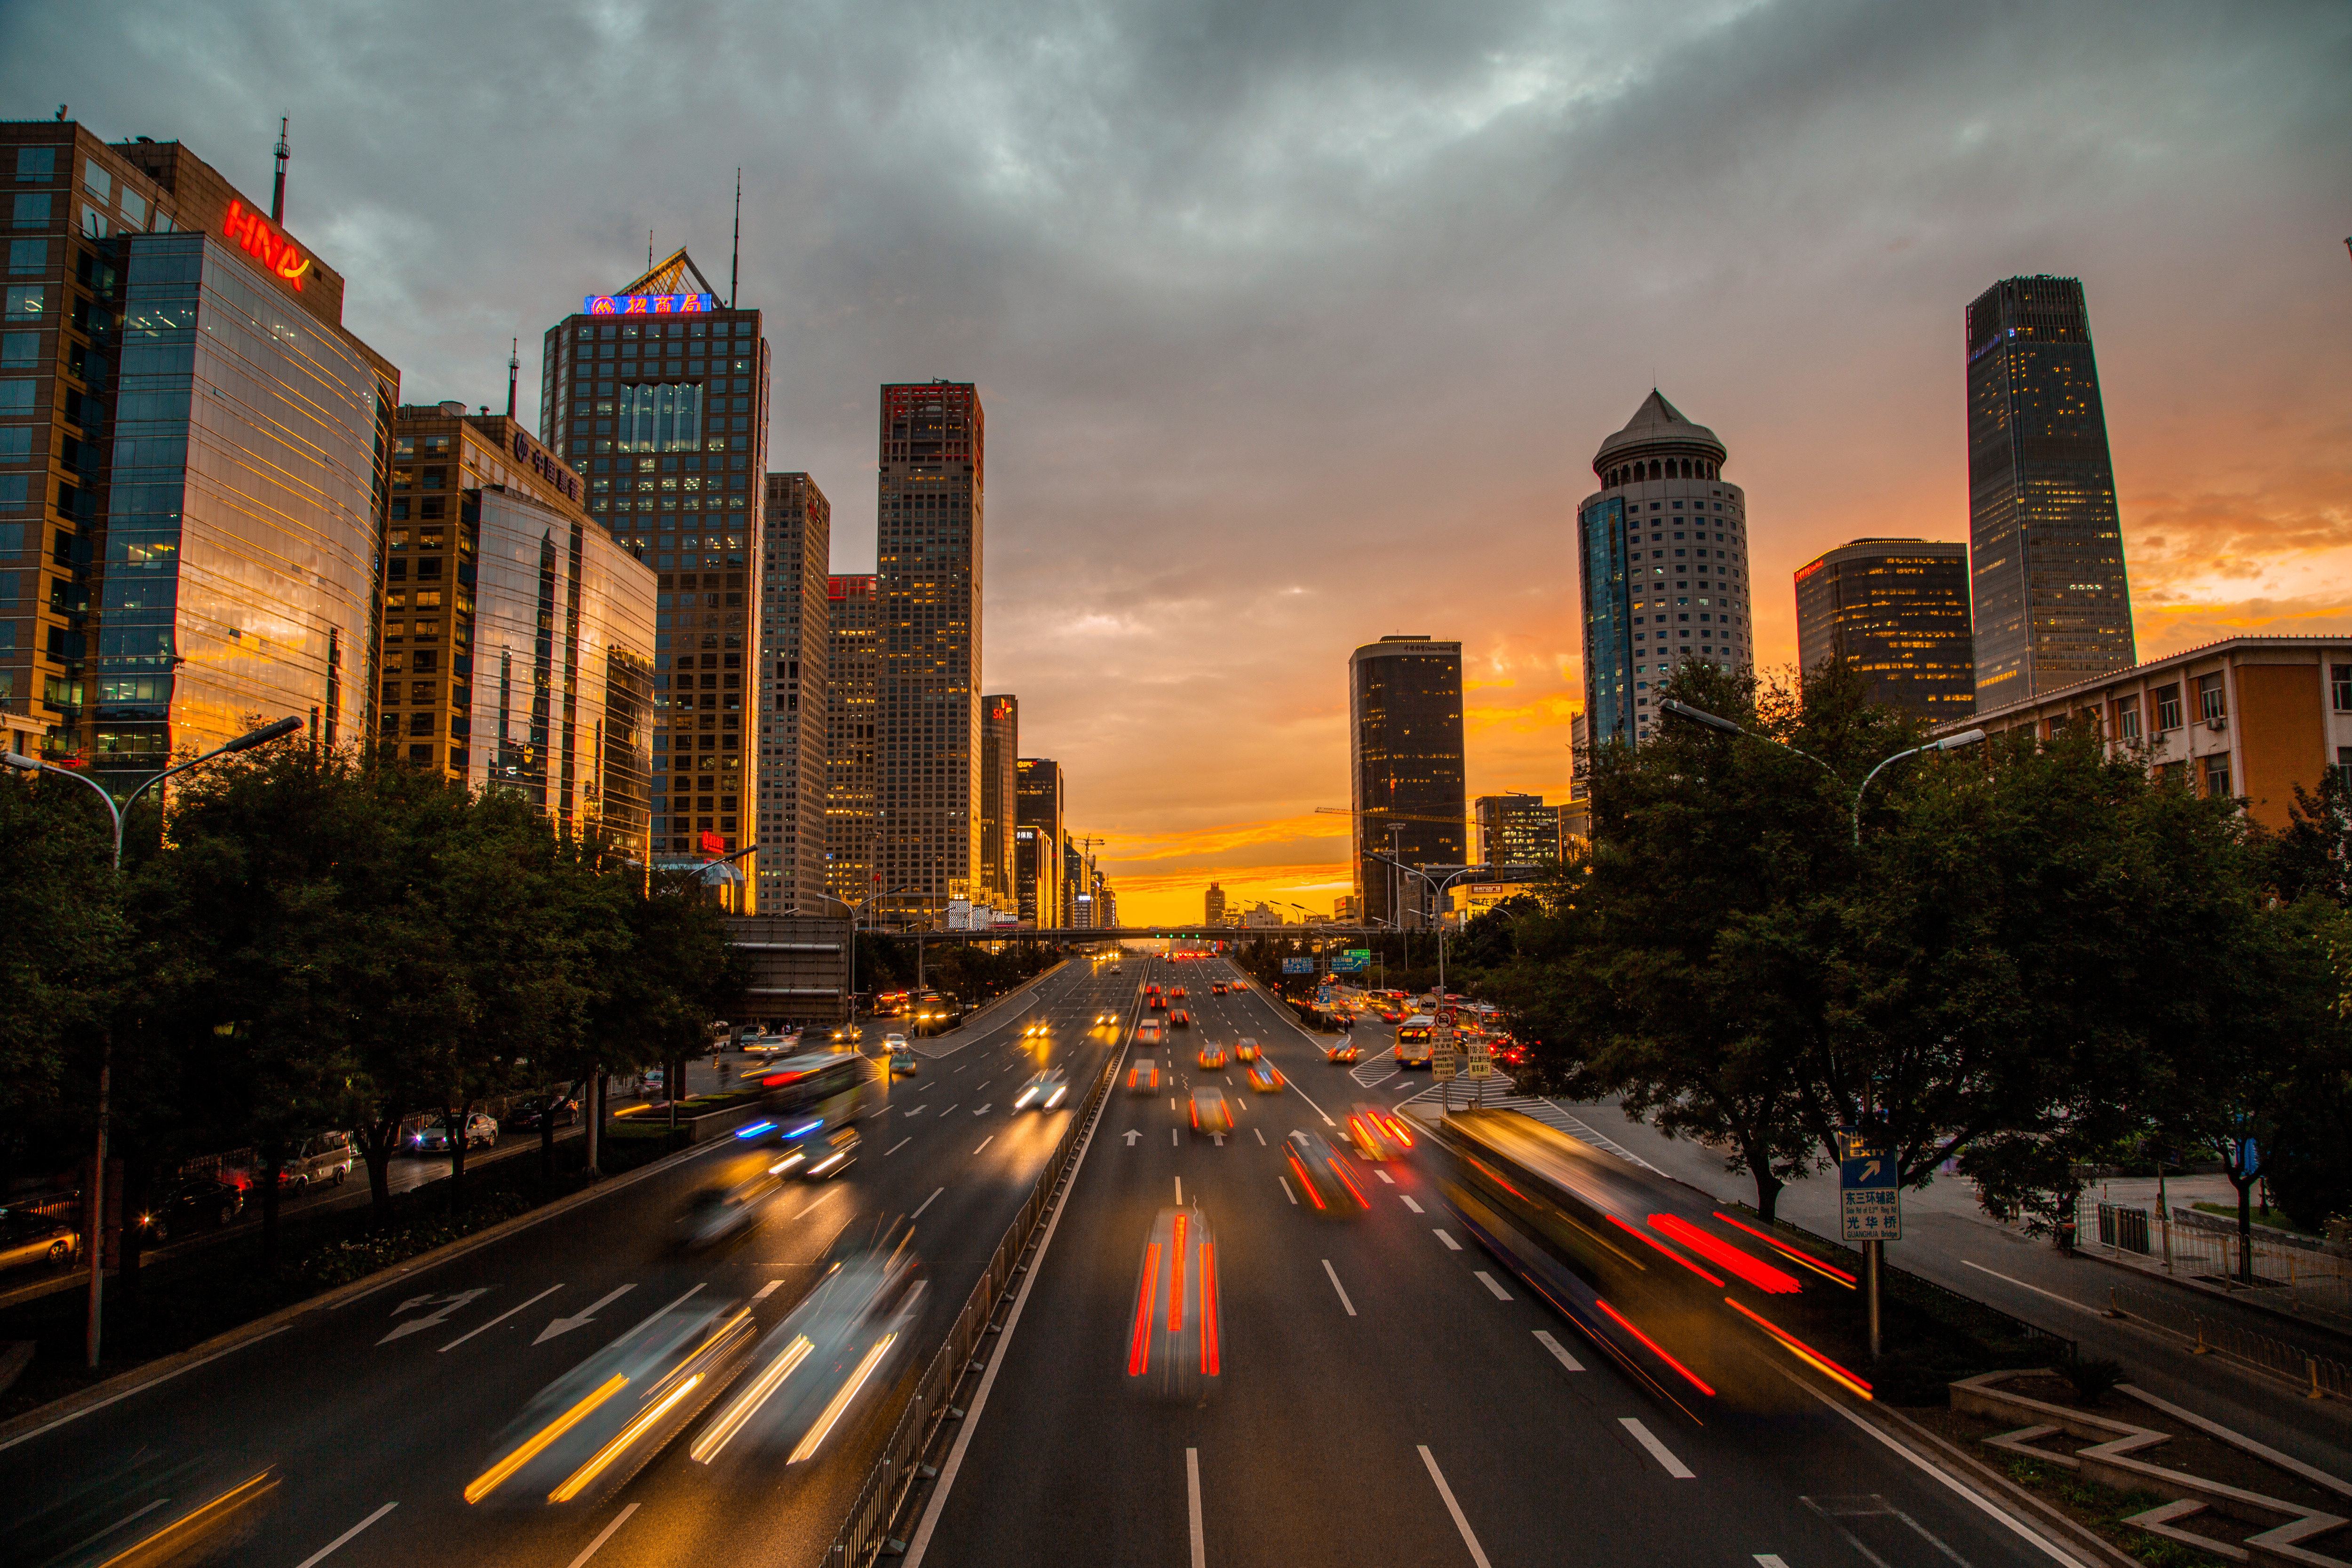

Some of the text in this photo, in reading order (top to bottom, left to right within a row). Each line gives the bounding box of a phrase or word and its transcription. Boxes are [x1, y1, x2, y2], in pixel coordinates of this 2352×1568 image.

[224, 200, 310, 292] HNA
[625, 294, 701, 313] 招商局
[517, 433, 579, 501] hp 中国惠普
[993, 708, 1005, 720] SK
[1846, 1191, 1896, 1205] 东三环辅路
[1847, 1216, 1897, 1229] 光华桥
